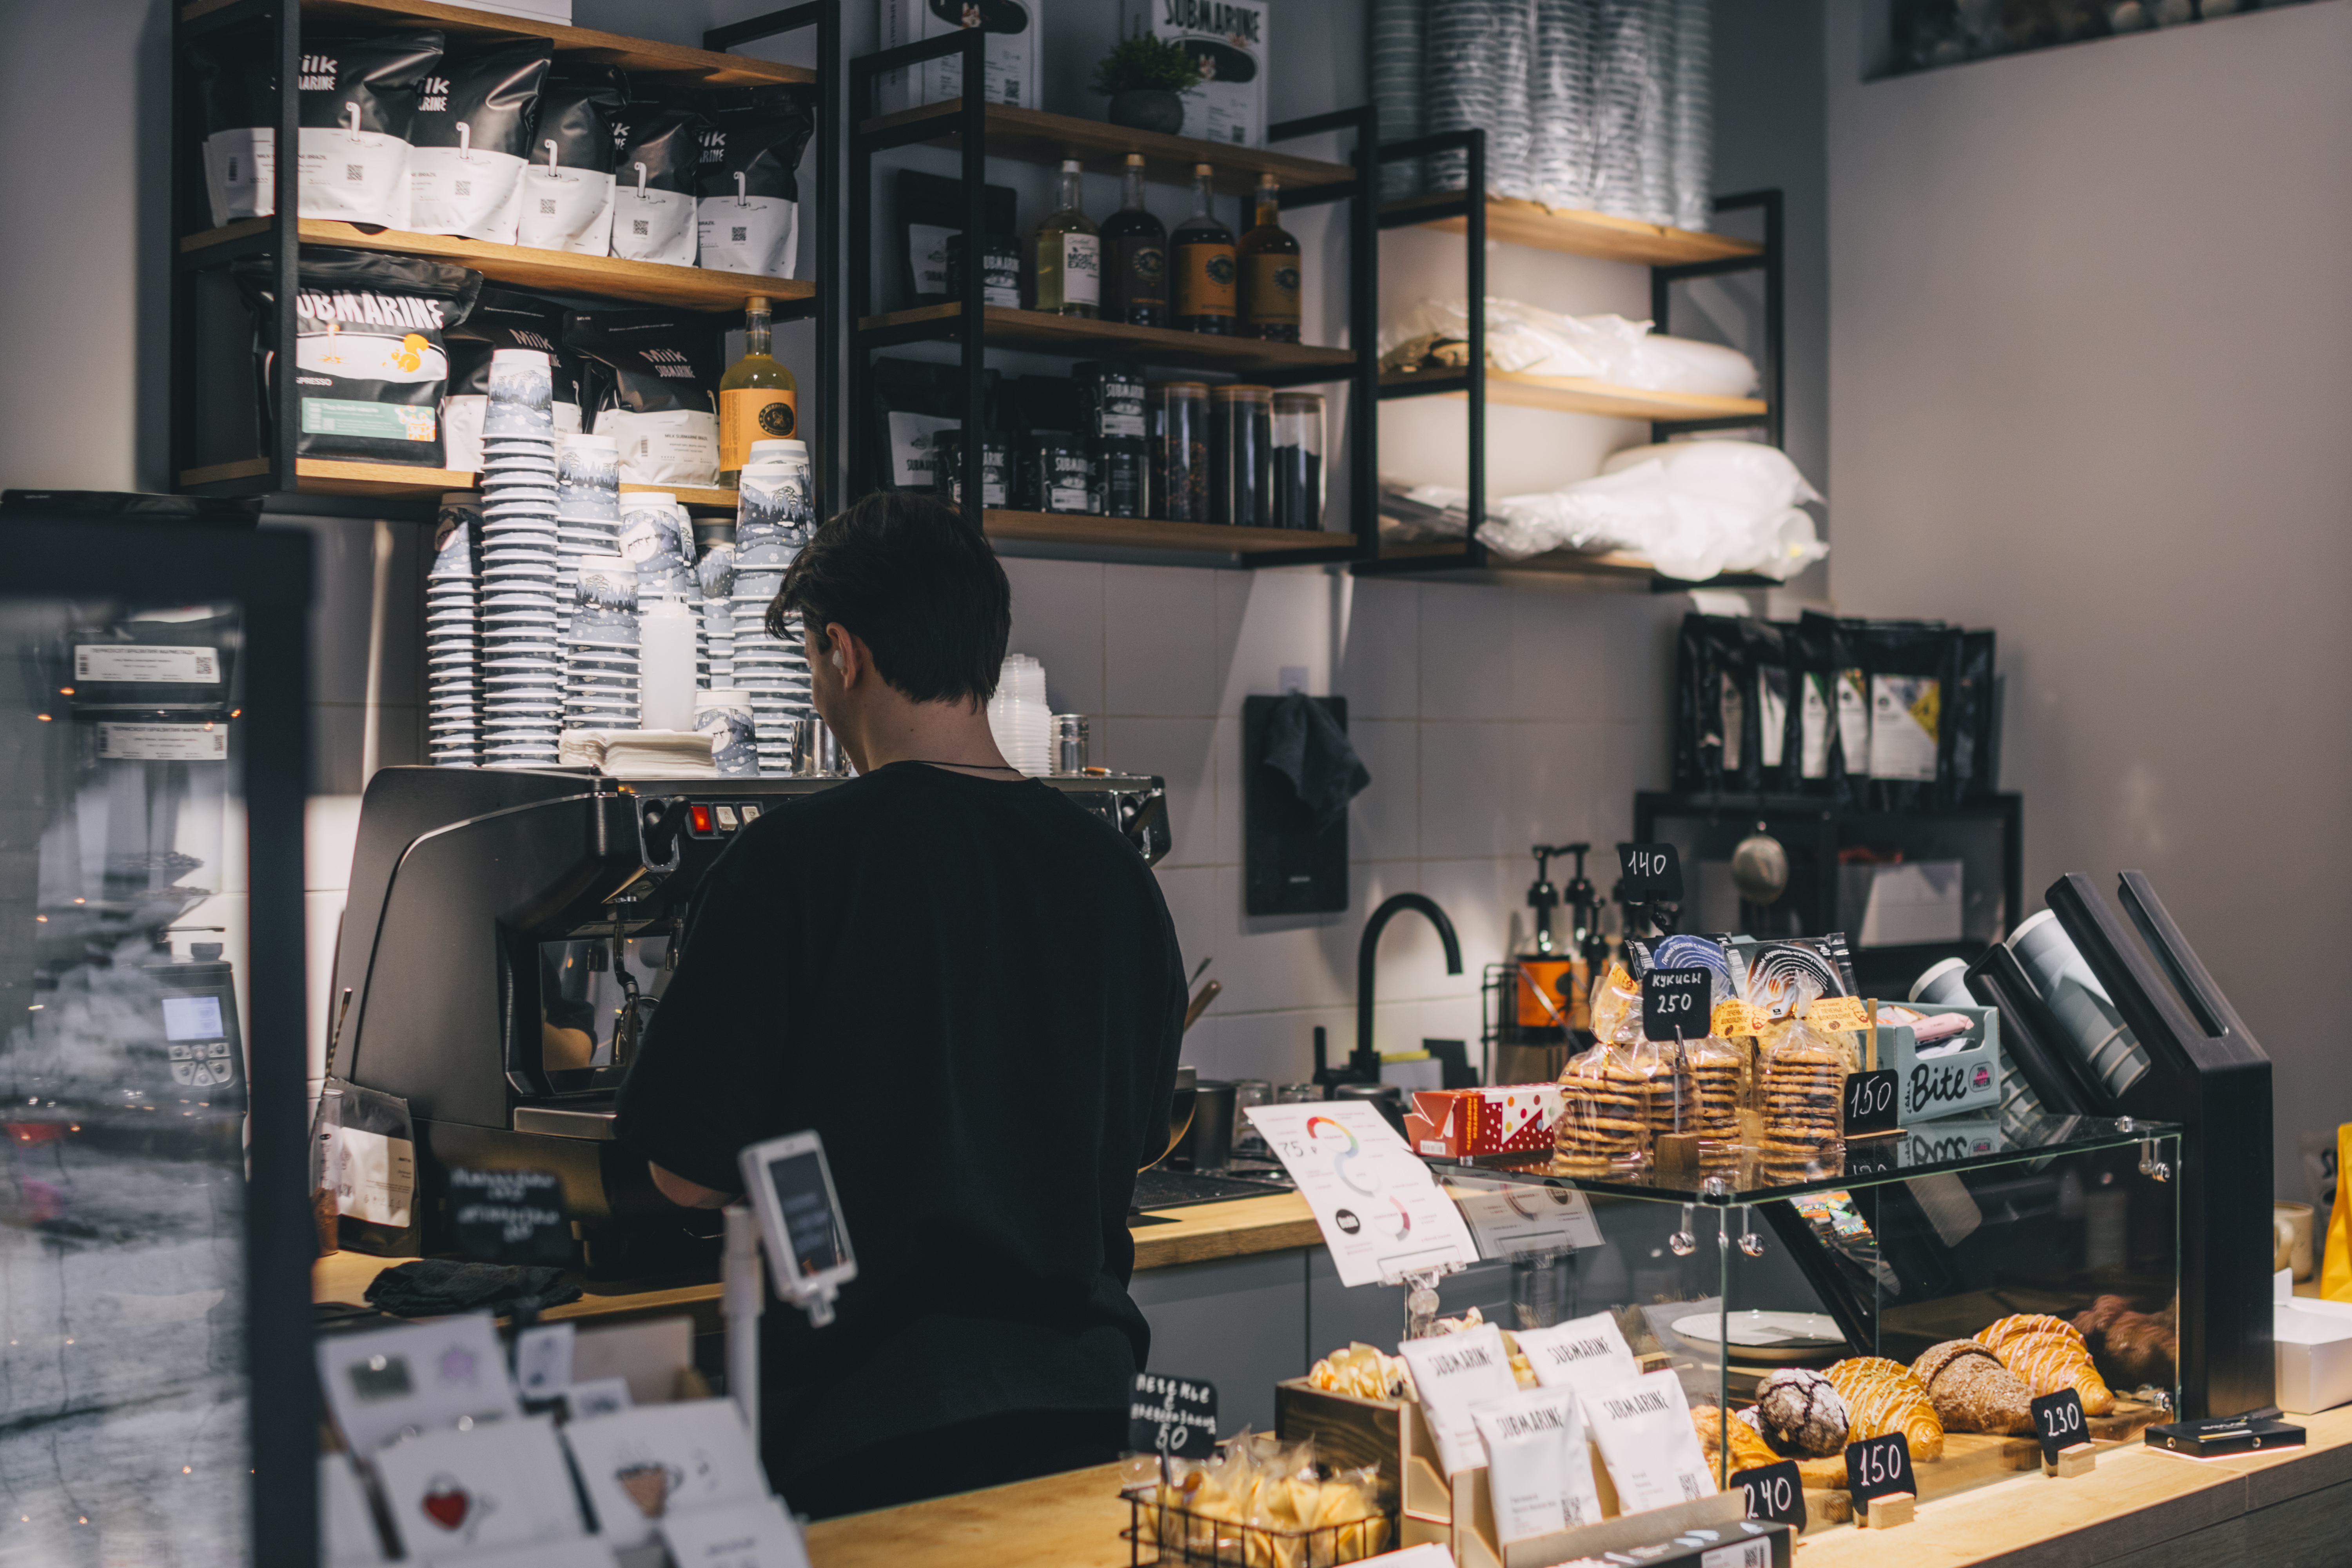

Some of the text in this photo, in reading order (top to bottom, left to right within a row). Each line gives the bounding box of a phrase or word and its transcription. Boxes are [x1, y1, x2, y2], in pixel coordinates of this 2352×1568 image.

[299, 54, 338, 74] ilk
[296, 289, 444, 330] UBMARINE
[509, 328, 554, 351] Milk
[639, 348, 687, 363] Milk
[655, 365, 695, 378] SUBMARINE
[1628, 851, 1666, 877] 140
[1661, 947, 1675, 965] Печенье
[1673, 942, 1693, 950] овсяное
[1751, 957, 1766, 984] Печенье
[1657, 993, 1692, 1013] 250
[1911, 1063, 1967, 1112] Bite
[1973, 1077, 1991, 1089] PROTEIN
[1850, 1076, 1891, 1118] 150
[1277, 1141, 1304, 1157] 75
[1428, 1347, 1493, 1377] SUBMARINE
[1546, 1336, 1614, 1366] SUBMARINE
[1603, 1390, 1670, 1420] SUBMARINE
[1495, 1405, 1565, 1440] SUBMARINE
[2043, 1402, 2080, 1437] 230
[1155, 1423, 1188, 1450] 50
[1860, 1443, 1901, 1487] 150
[1744, 1475, 1792, 1520] 240
